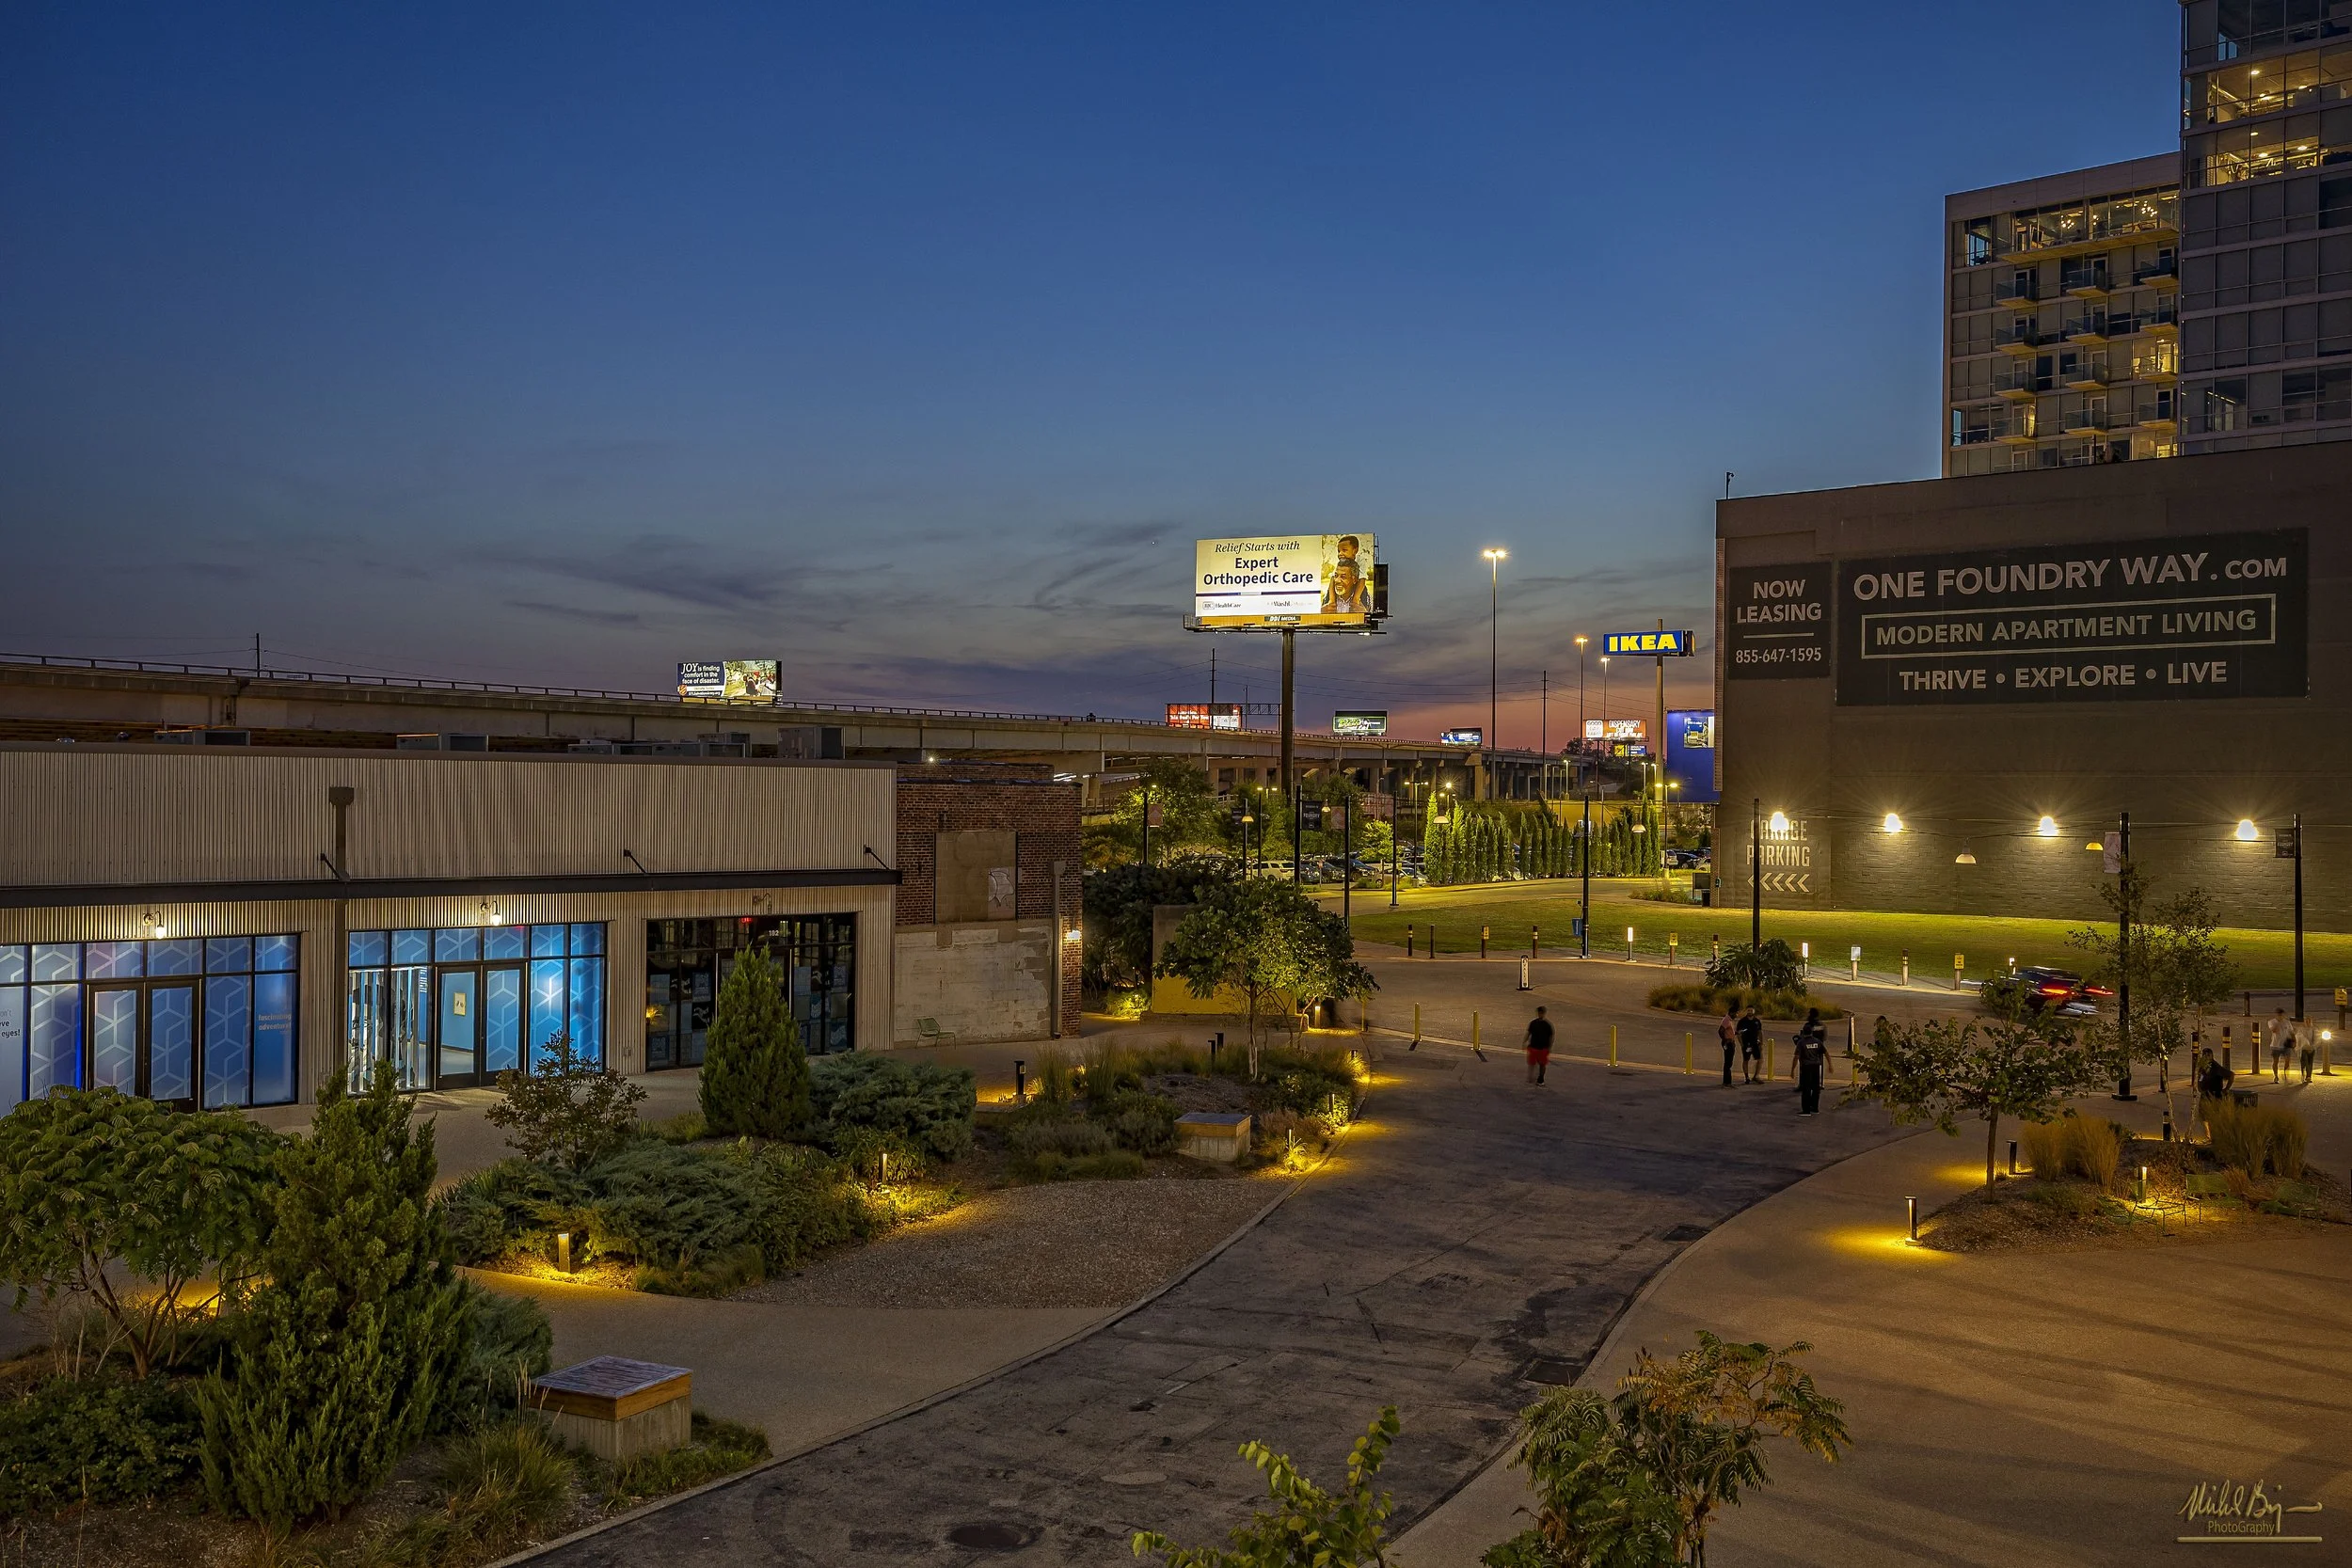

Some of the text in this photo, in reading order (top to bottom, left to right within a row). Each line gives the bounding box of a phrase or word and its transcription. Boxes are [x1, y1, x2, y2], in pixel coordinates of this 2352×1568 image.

[1215, 541, 1300, 554] Relief Starts with
[1235, 556, 1278, 571] Expert
[1204, 571, 1313, 587] Orthopedic Care
[1853, 571, 1925, 601] ONE
[1938, 559, 2110, 596] FOUNDRY
[2121, 553, 2208, 585] WAY
[1753, 579, 1806, 599] NOW
[1737, 603, 1822, 623] LEASING
[1877, 610, 2256, 645] MODERN APARTMENT LIVING
[1609, 634, 1677, 651] IKEA
[1736, 648, 1822, 663] 855-647-1595
[681, 663, 699, 674] JOY
[1899, 662, 2227, 691] THRIVE EXPLORE LIVE
[1750, 820, 1807, 841] ARAGE
[1747, 845, 1810, 867] PARKING
[2, 1029, 20, 1038] eyes!
